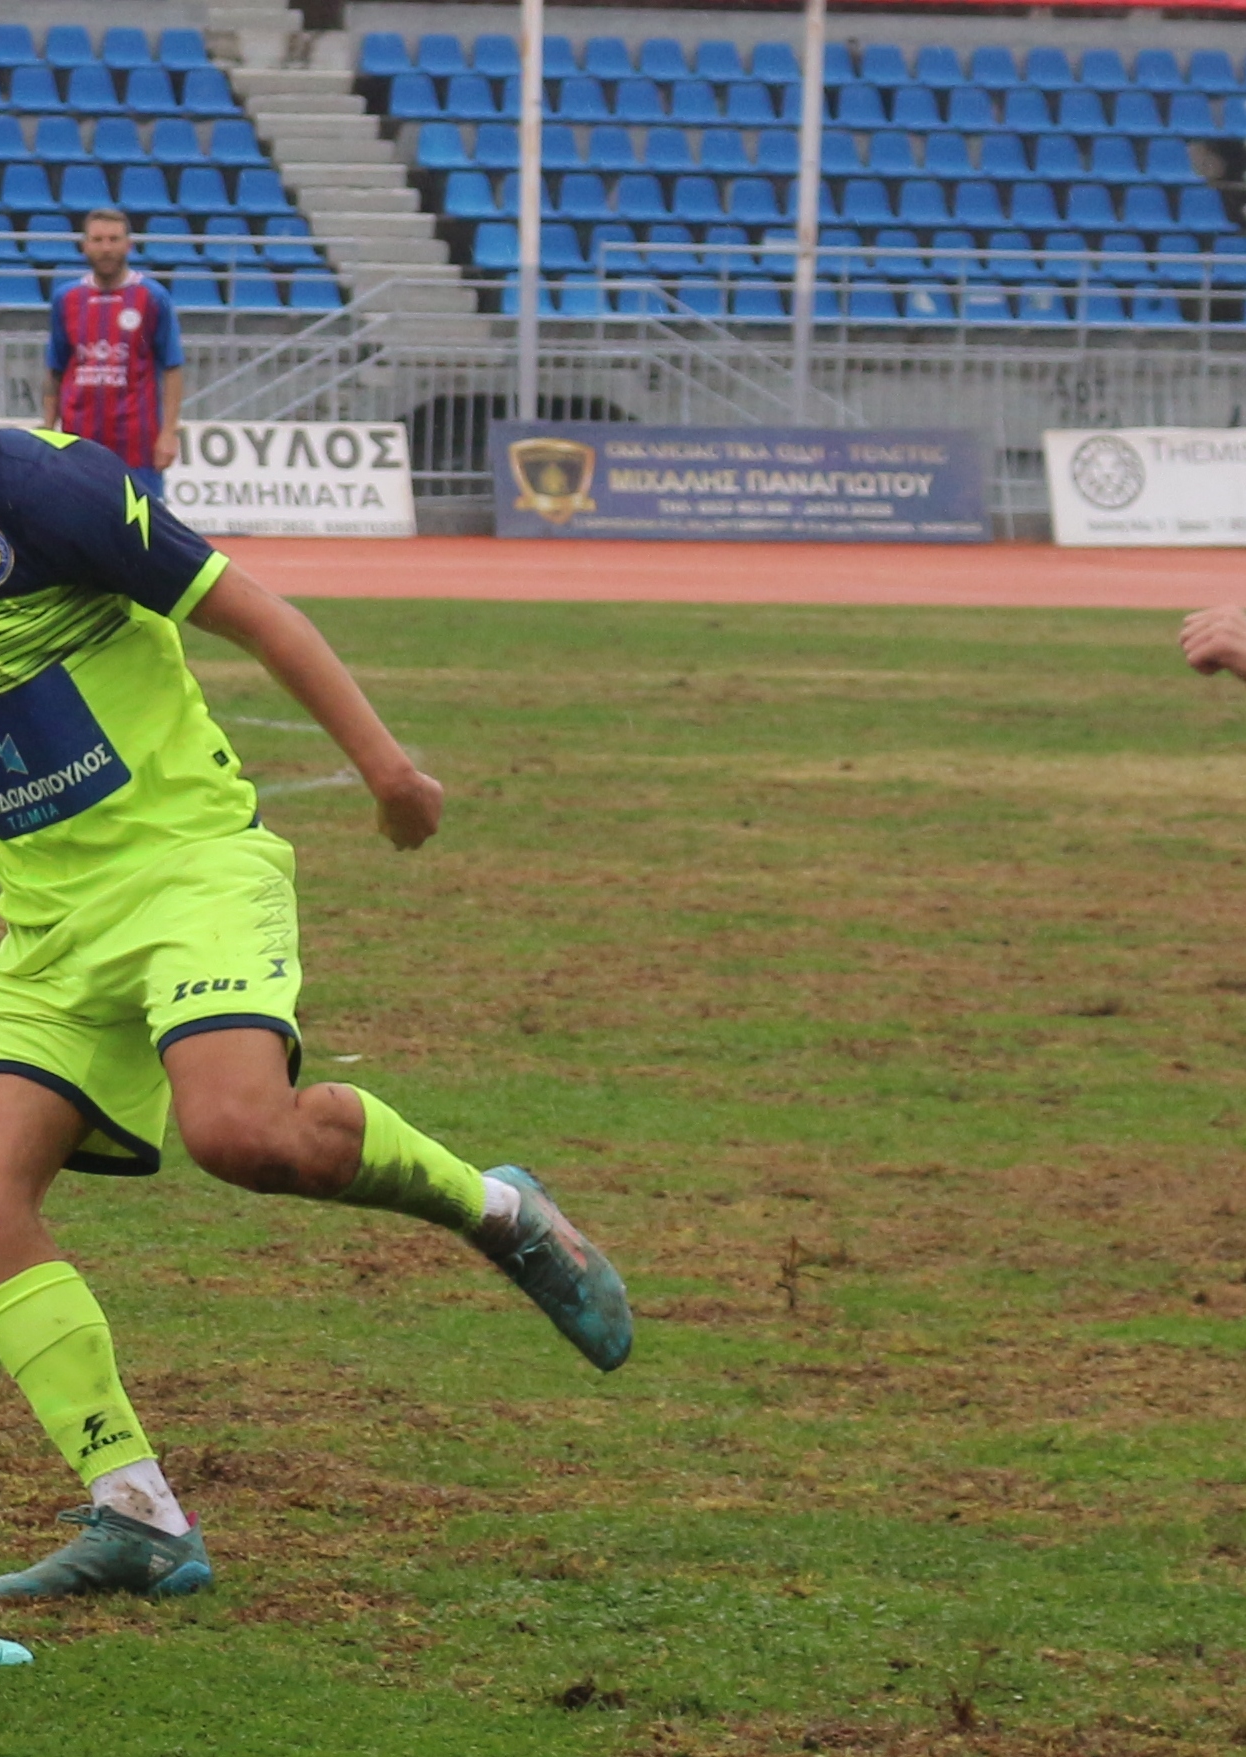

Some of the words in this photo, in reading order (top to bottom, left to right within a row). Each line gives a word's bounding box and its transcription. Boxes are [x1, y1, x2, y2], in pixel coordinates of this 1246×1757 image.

[166, 480, 385, 508] ΟΣΜΗΜΑΤΑ
[609, 468, 741, 494] ΜΙΧΑΛΗΣ
[747, 470, 935, 498] ΠΑΝΑΓΙΩΤΟΥ
